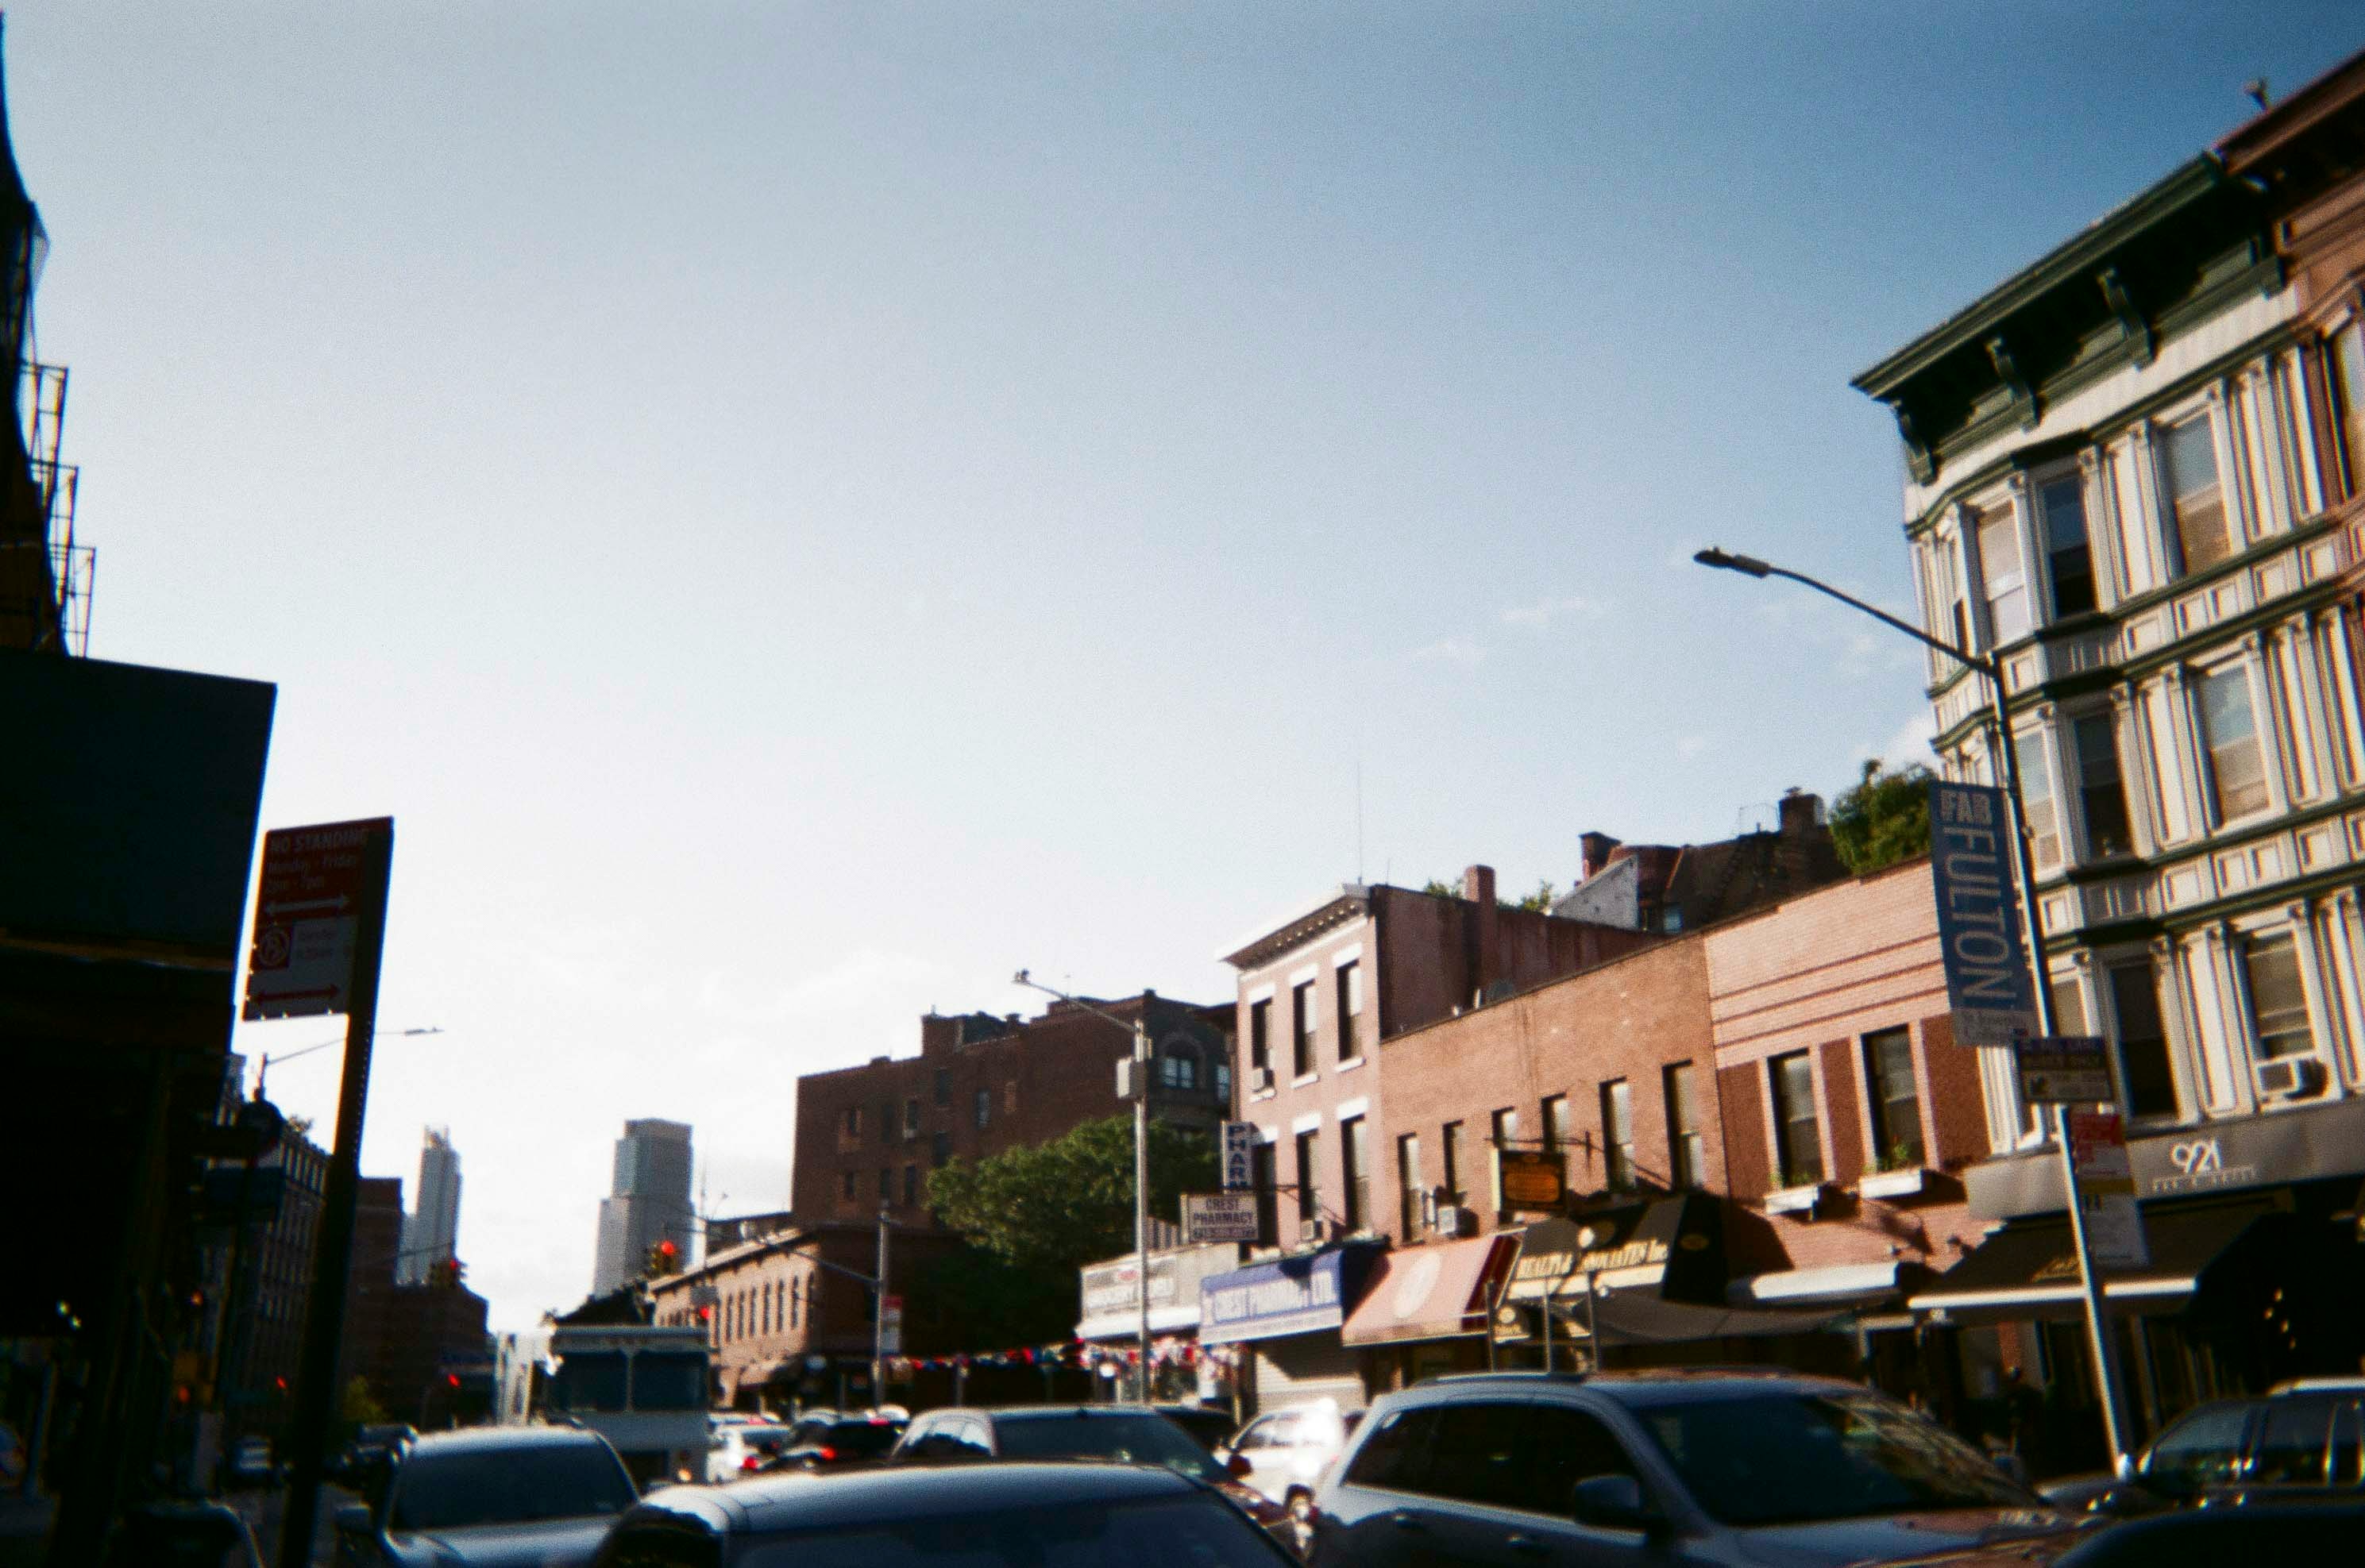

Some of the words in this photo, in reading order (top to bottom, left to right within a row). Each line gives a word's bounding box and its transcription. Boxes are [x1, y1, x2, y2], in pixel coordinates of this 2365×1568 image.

[1940, 789, 1993, 825] FAB
[270, 836, 290, 854] NO
[1943, 826, 2017, 999] FULTON
[2170, 1139, 2221, 1173] 921
[1206, 1197, 1240, 1211] CREST
[1193, 1212, 1253, 1226] PHARMACY
